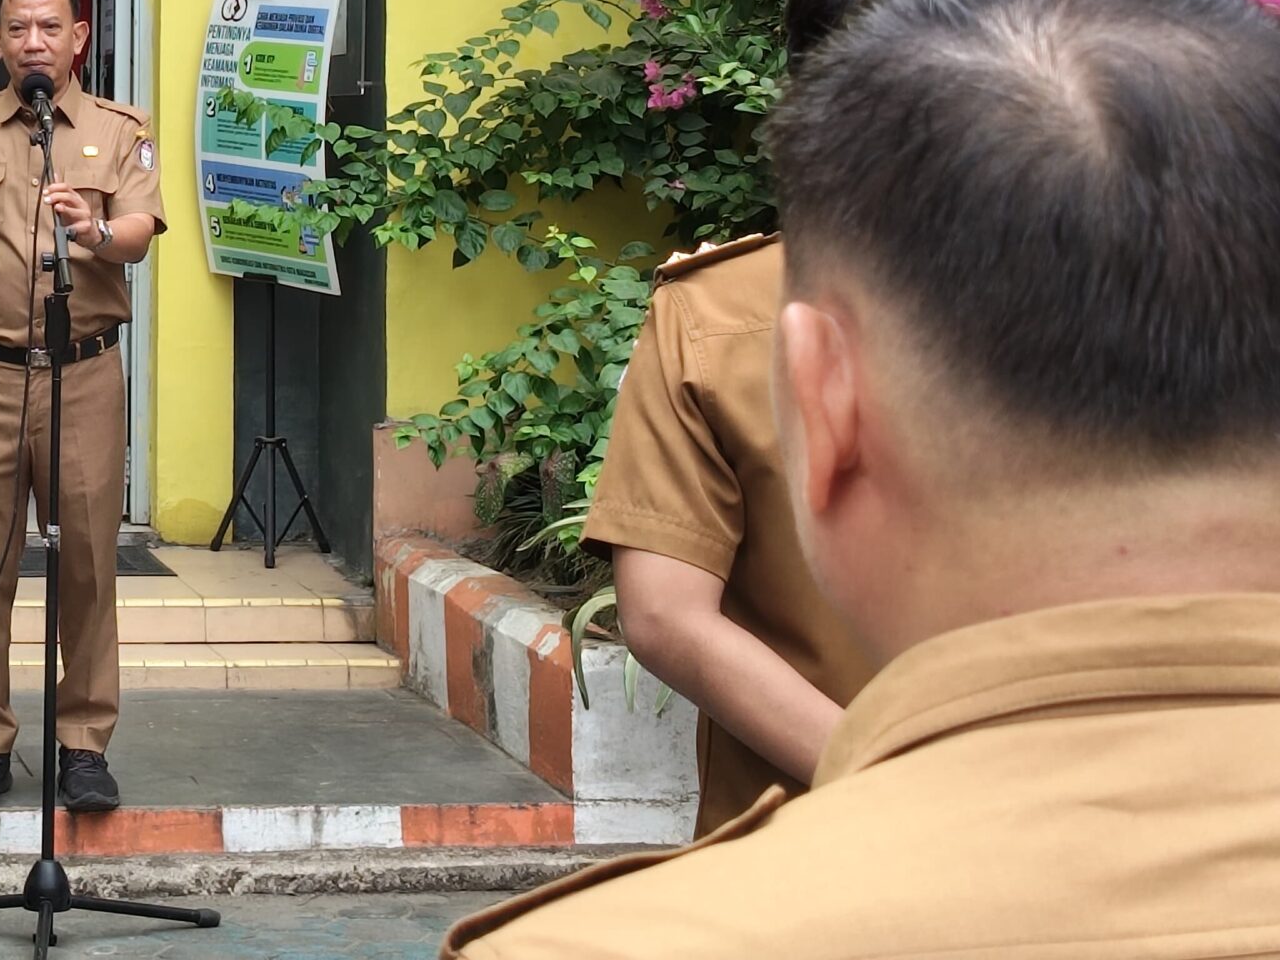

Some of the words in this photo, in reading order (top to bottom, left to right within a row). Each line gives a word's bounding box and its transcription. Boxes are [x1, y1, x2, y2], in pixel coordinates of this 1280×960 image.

[208, 25, 251, 41] PENTINGNYA
[206, 42, 235, 56] MENJAGA
[203, 58, 238, 74] KEAMANAN
[244, 54, 253, 74] 1
[201, 74, 235, 89] INFORMASI
[206, 97, 216, 117] 2
[205, 173, 215, 193] 4
[210, 216, 221, 237] 5
